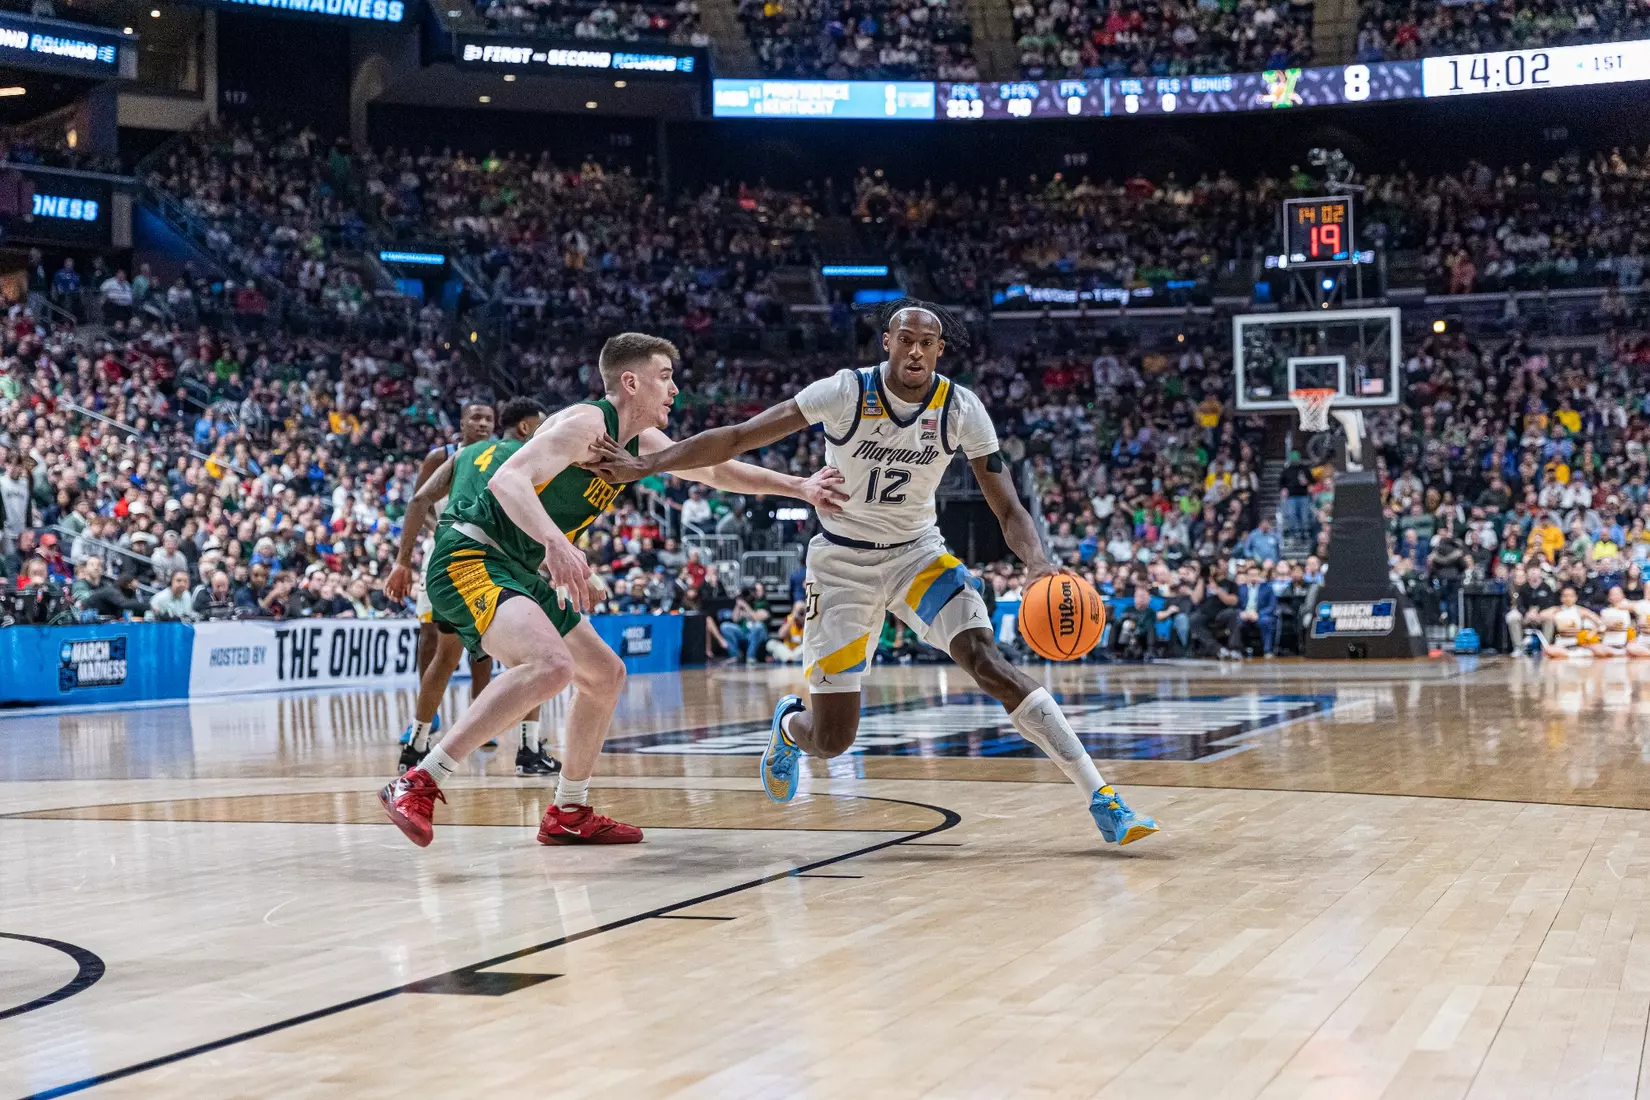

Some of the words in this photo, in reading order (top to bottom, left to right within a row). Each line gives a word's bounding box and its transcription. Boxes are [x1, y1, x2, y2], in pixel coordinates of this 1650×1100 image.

[483, 46, 533, 63] FIRST
[547, 50, 611, 68] SECOND
[1449, 53, 1550, 91] 14:02
[1594, 55, 1624, 71] 1ST
[1344, 65, 1370, 101] 8
[1310, 224, 1341, 257] 19
[474, 445, 496, 472] 4
[852, 440, 940, 466] Marquette
[864, 467, 912, 505] 12
[1058, 581, 1075, 636] Wilson
[71, 641, 111, 663] MARCH
[210, 648, 249, 667] HOSTED
[252, 646, 267, 664] BY
[275, 628, 322, 680] THE
[328, 628, 388, 677] OHIO
[77, 659, 127, 682] MADNESS
